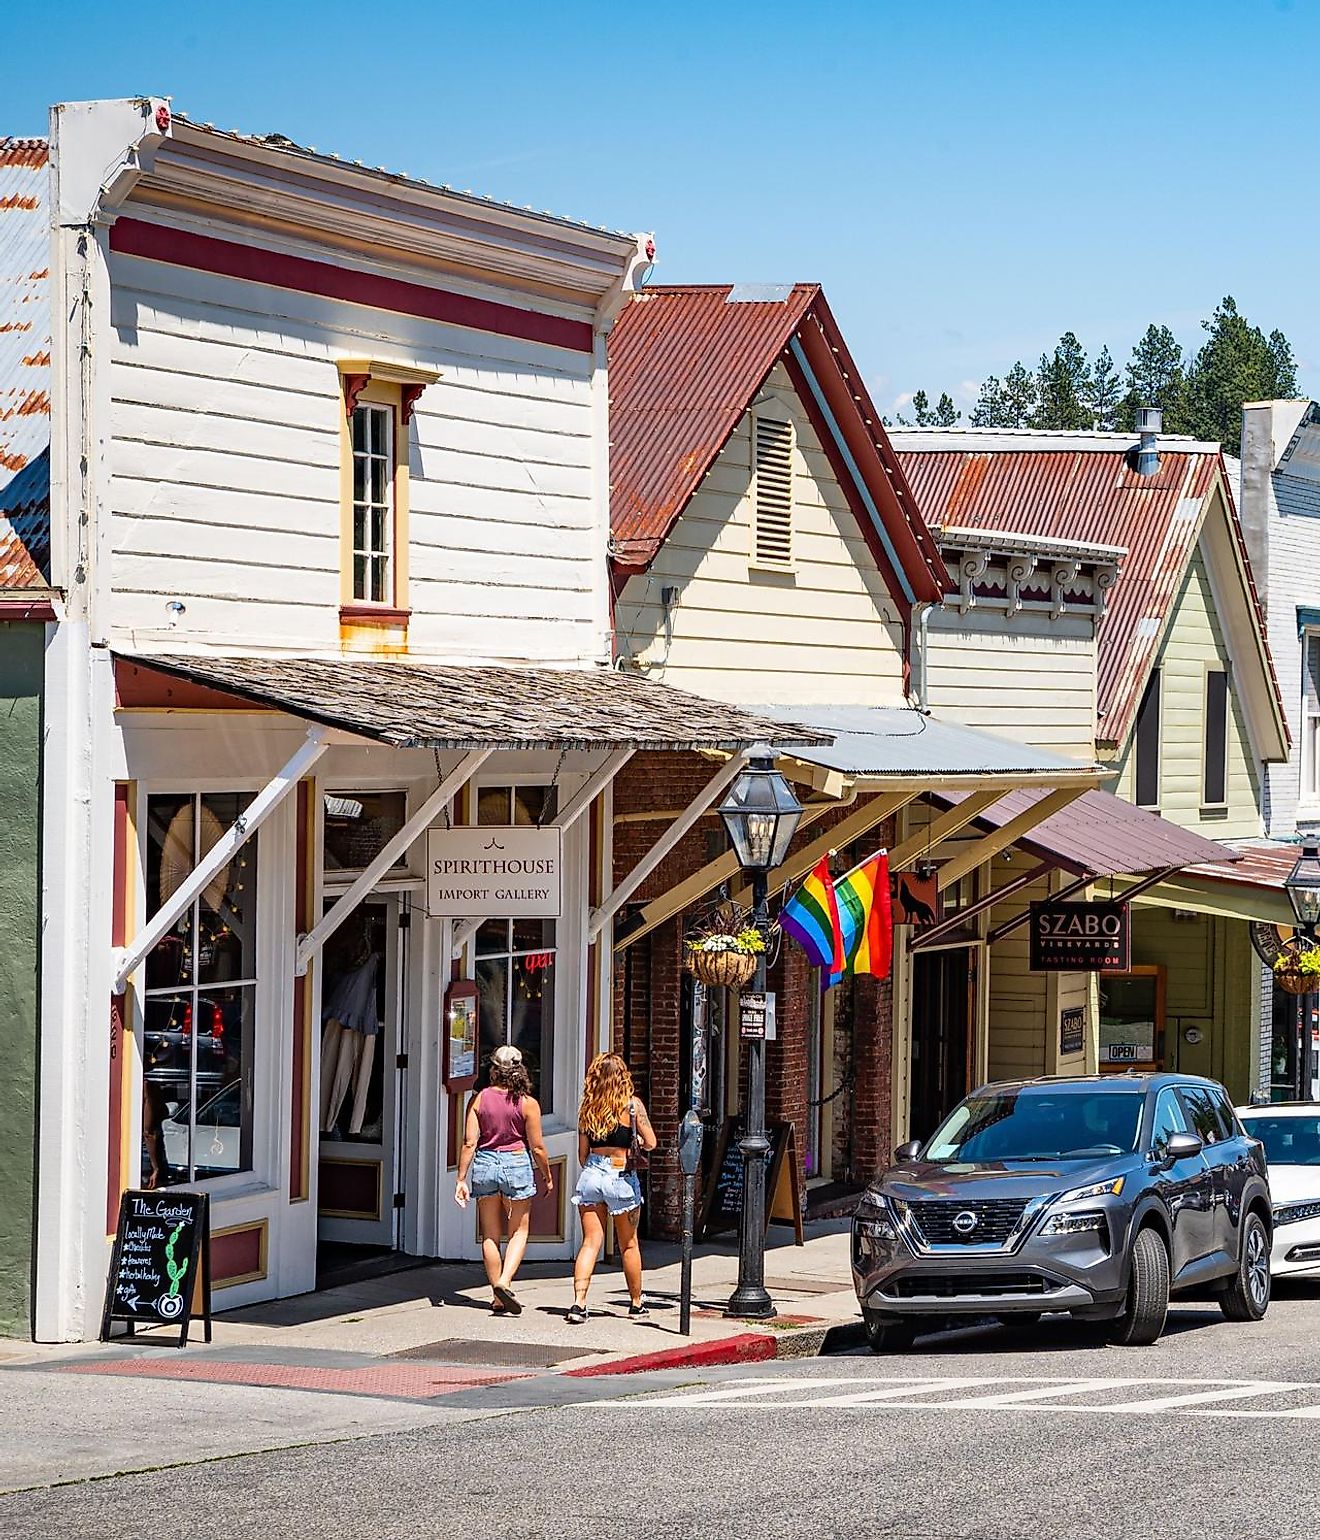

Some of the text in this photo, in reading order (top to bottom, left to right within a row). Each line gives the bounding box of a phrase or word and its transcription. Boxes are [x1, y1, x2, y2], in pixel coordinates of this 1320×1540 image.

[434, 859, 555, 875] SPIRITHOUSE
[439, 889, 550, 900] IMPORT GALLERY
[1039, 914, 1121, 935] SZABO
[1040, 941, 1120, 949] VINEYARDS
[1090, 956, 1120, 964] ROOM
[1064, 1016, 1082, 1032] SZABO
[1112, 1046, 1134, 1058] OPEN
[132, 1198, 193, 1219] The Garden
